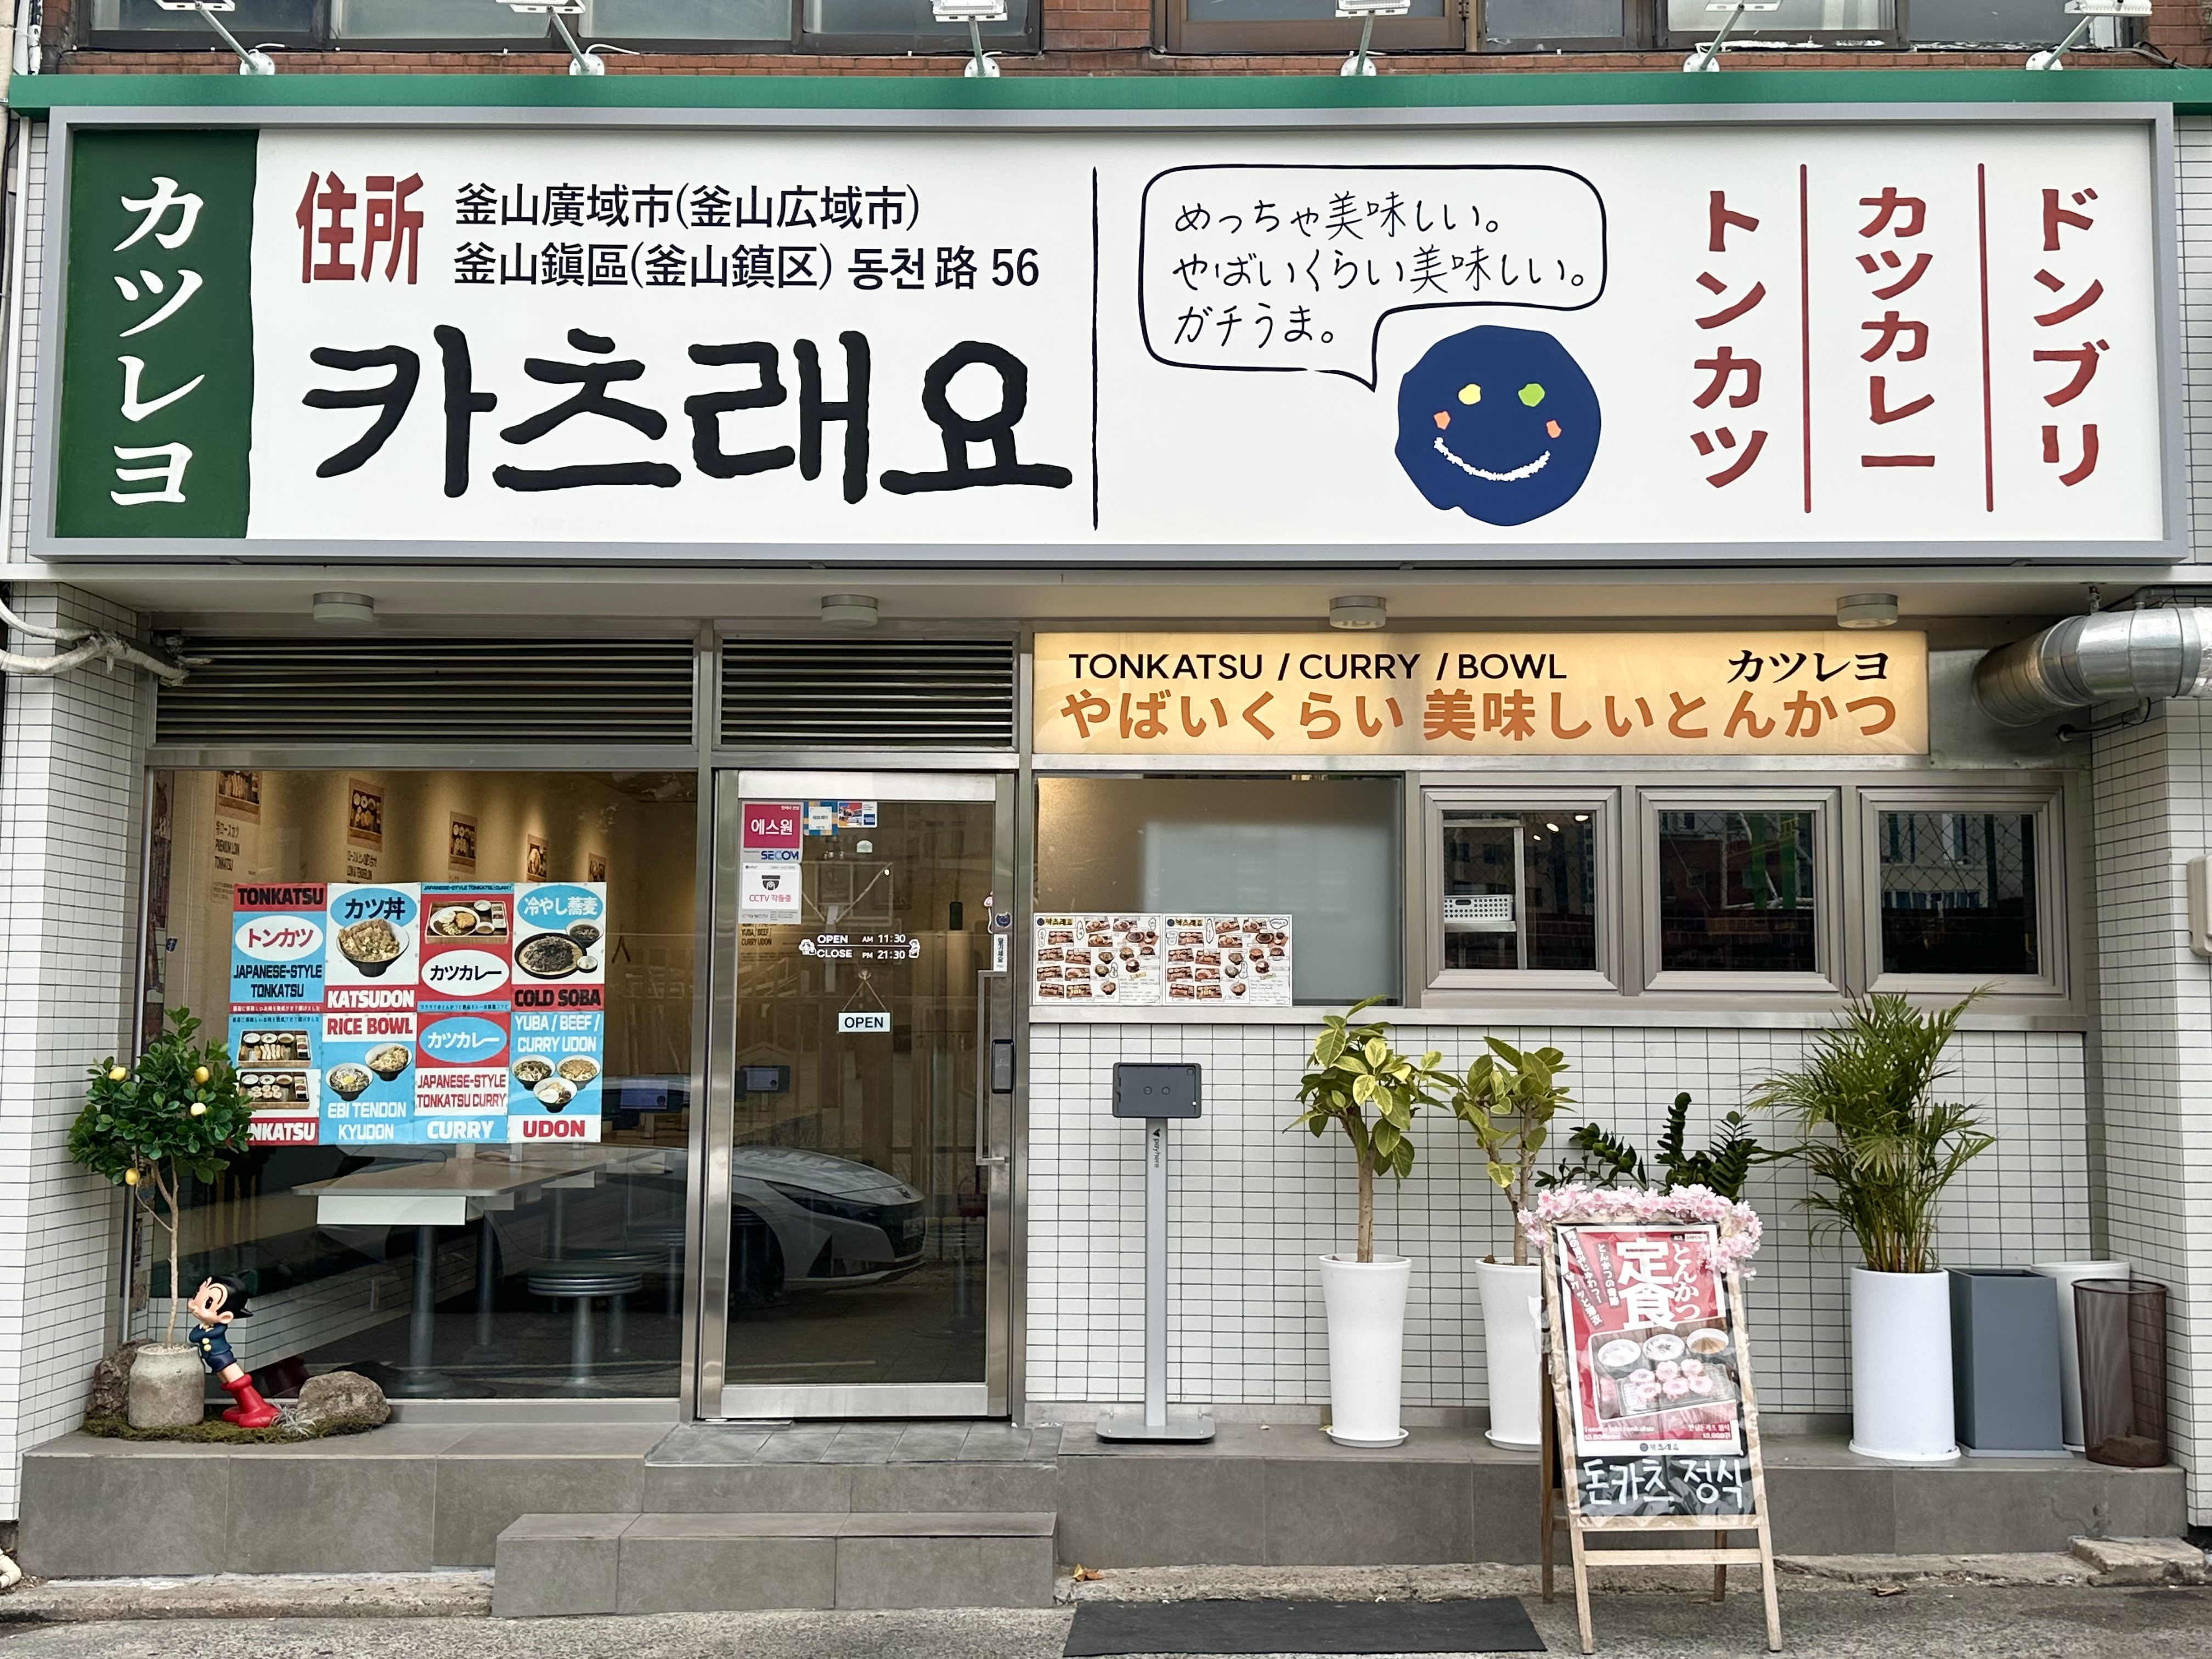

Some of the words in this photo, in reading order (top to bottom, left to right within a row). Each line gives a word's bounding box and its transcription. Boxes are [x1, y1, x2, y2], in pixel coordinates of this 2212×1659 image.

[455, 182, 920, 231] 釜山廣域市(釜山広域市)
[1175, 190, 1499, 240] めっちゃ美味しい。
[296, 171, 424, 285] 住所
[992, 248, 1040, 287] 56
[1173, 245, 1584, 294] やばいくらい美味しい。
[1174, 303, 1334, 348] ガチうま。
[1855, 187, 1936, 467] カツカレー
[110, 176, 205, 505] カツレヨ
[1690, 190, 1768, 488] トンカツ
[2033, 187, 2110, 487] ドンブリ
[302, 324, 1073, 504] 카츠래요
[1069, 653, 1262, 680] TONKATSU
[1727, 650, 1888, 684] カツレヨ
[751, 819, 793, 836] 에스원
[761, 850, 799, 860] SECOM
[238, 887, 324, 905] TONKATSU
[345, 897, 406, 919] カツ丼
[524, 896, 597, 916] 冷やし蕎麦
[249, 928, 313, 947] トンカツ
[817, 935, 848, 944] OPEN
[878, 934, 906, 943] 11:30
[817, 949, 852, 958] CLOSE
[877, 950, 906, 959] 21:30
[233, 964, 323, 979] JAPANESE-STYLE
[430, 965, 502, 981] カツカレー
[251, 984, 304, 998] TONKATSU
[328, 990, 415, 1008] KATSUDON
[515, 990, 555, 1007] COLD
[558, 989, 601, 1007] SOBA
[328, 1017, 362, 1035] RICE
[367, 1017, 413, 1035] BOWL
[515, 1015, 549, 1031] YUBA
[560, 1014, 592, 1031] BEEF
[844, 1017, 884, 1029] OPEN
[427, 1032, 500, 1048] カツカレー
[517, 1036, 561, 1052] CURRY
[562, 1036, 597, 1052] UDON
[417, 1074, 506, 1088] JAPANESE-STYLE
[417, 1093, 471, 1108] TONKATSU
[472, 1093, 507, 1108] CURRY
[328, 1102, 350, 1119] EBI
[352, 1102, 407, 1118] TENDON
[248, 1122, 315, 1142] NKATSU
[338, 1124, 394, 1141] KYUDON
[427, 1121, 494, 1139] CURRY
[523, 1120, 585, 1138] UDON
[1616, 1238, 1679, 1330] 定食
[1672, 1243, 1701, 1320] とんかつ
[1583, 1458, 1674, 1505] 돈카츠
[1679, 1458, 1743, 1509] 정식
